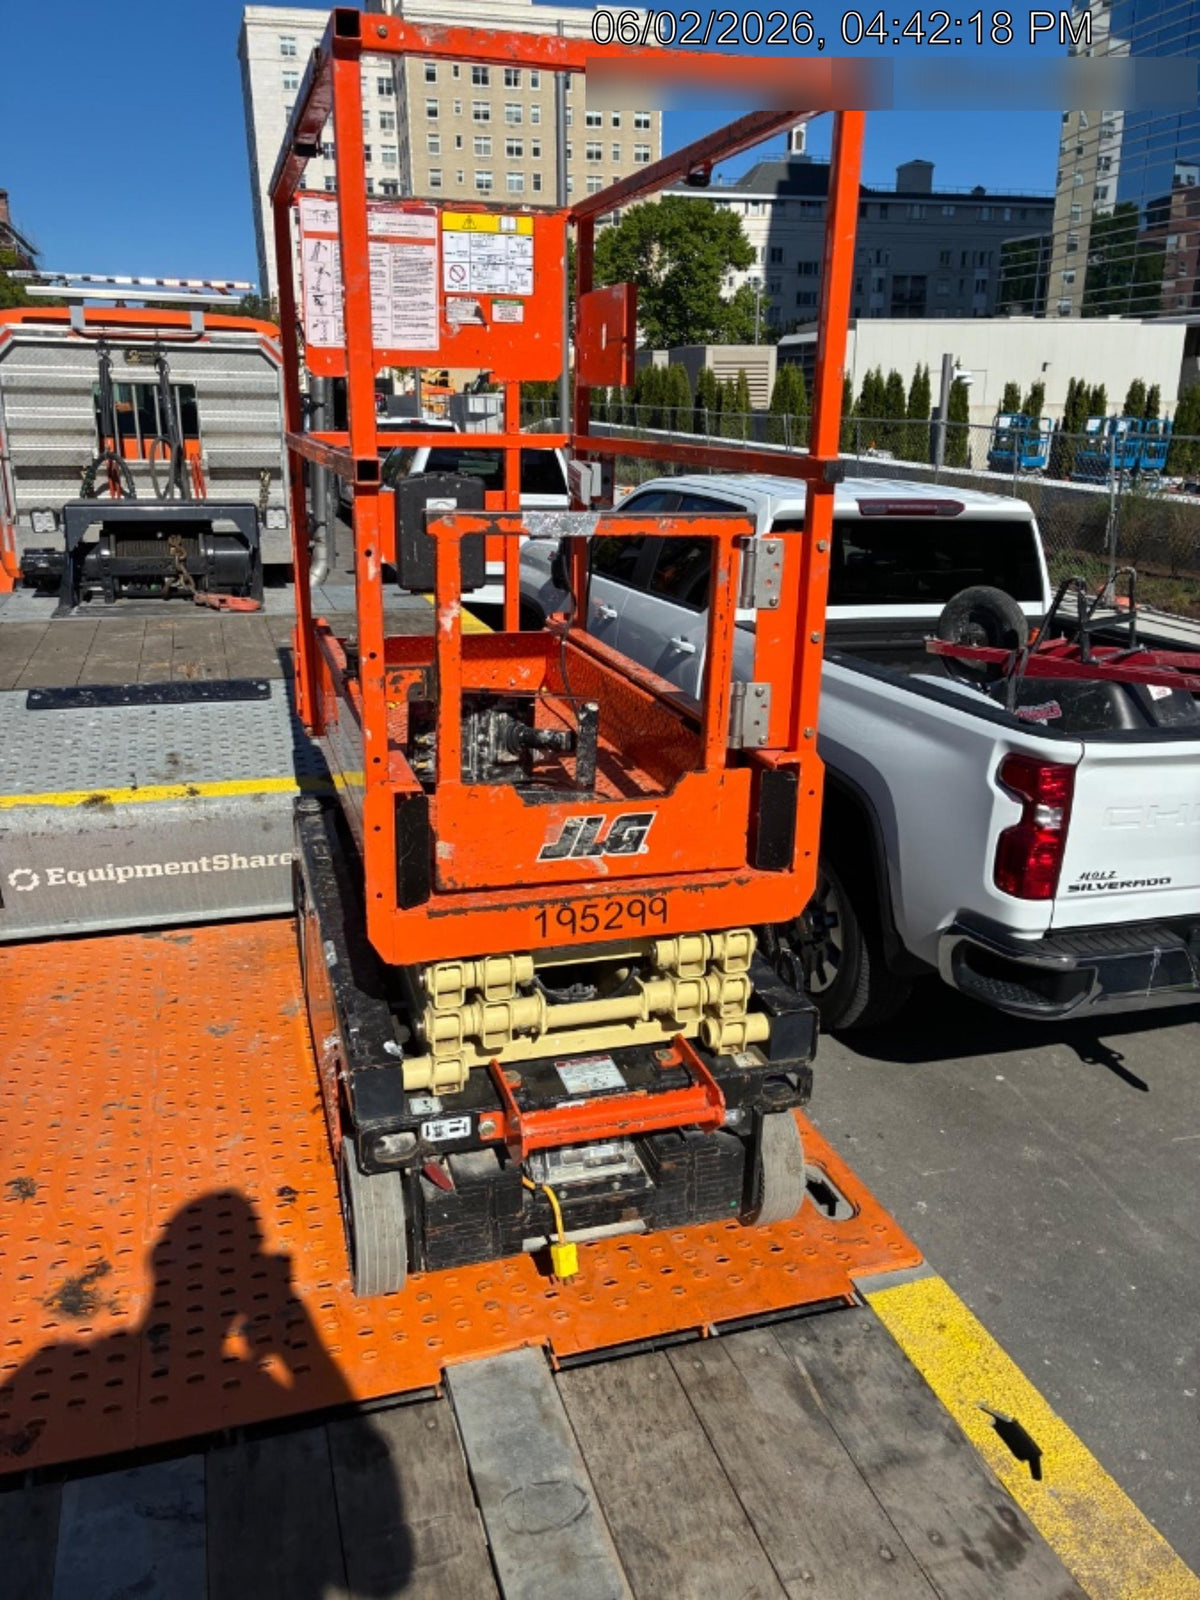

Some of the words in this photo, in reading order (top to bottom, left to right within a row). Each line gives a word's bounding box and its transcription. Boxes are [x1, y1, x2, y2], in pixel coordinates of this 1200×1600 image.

[536, 811, 657, 862] JLG
[46, 852, 292, 888] EquipmentShare
[1068, 877, 1172, 893] SILVERADO
[534, 896, 667, 938] 195299
